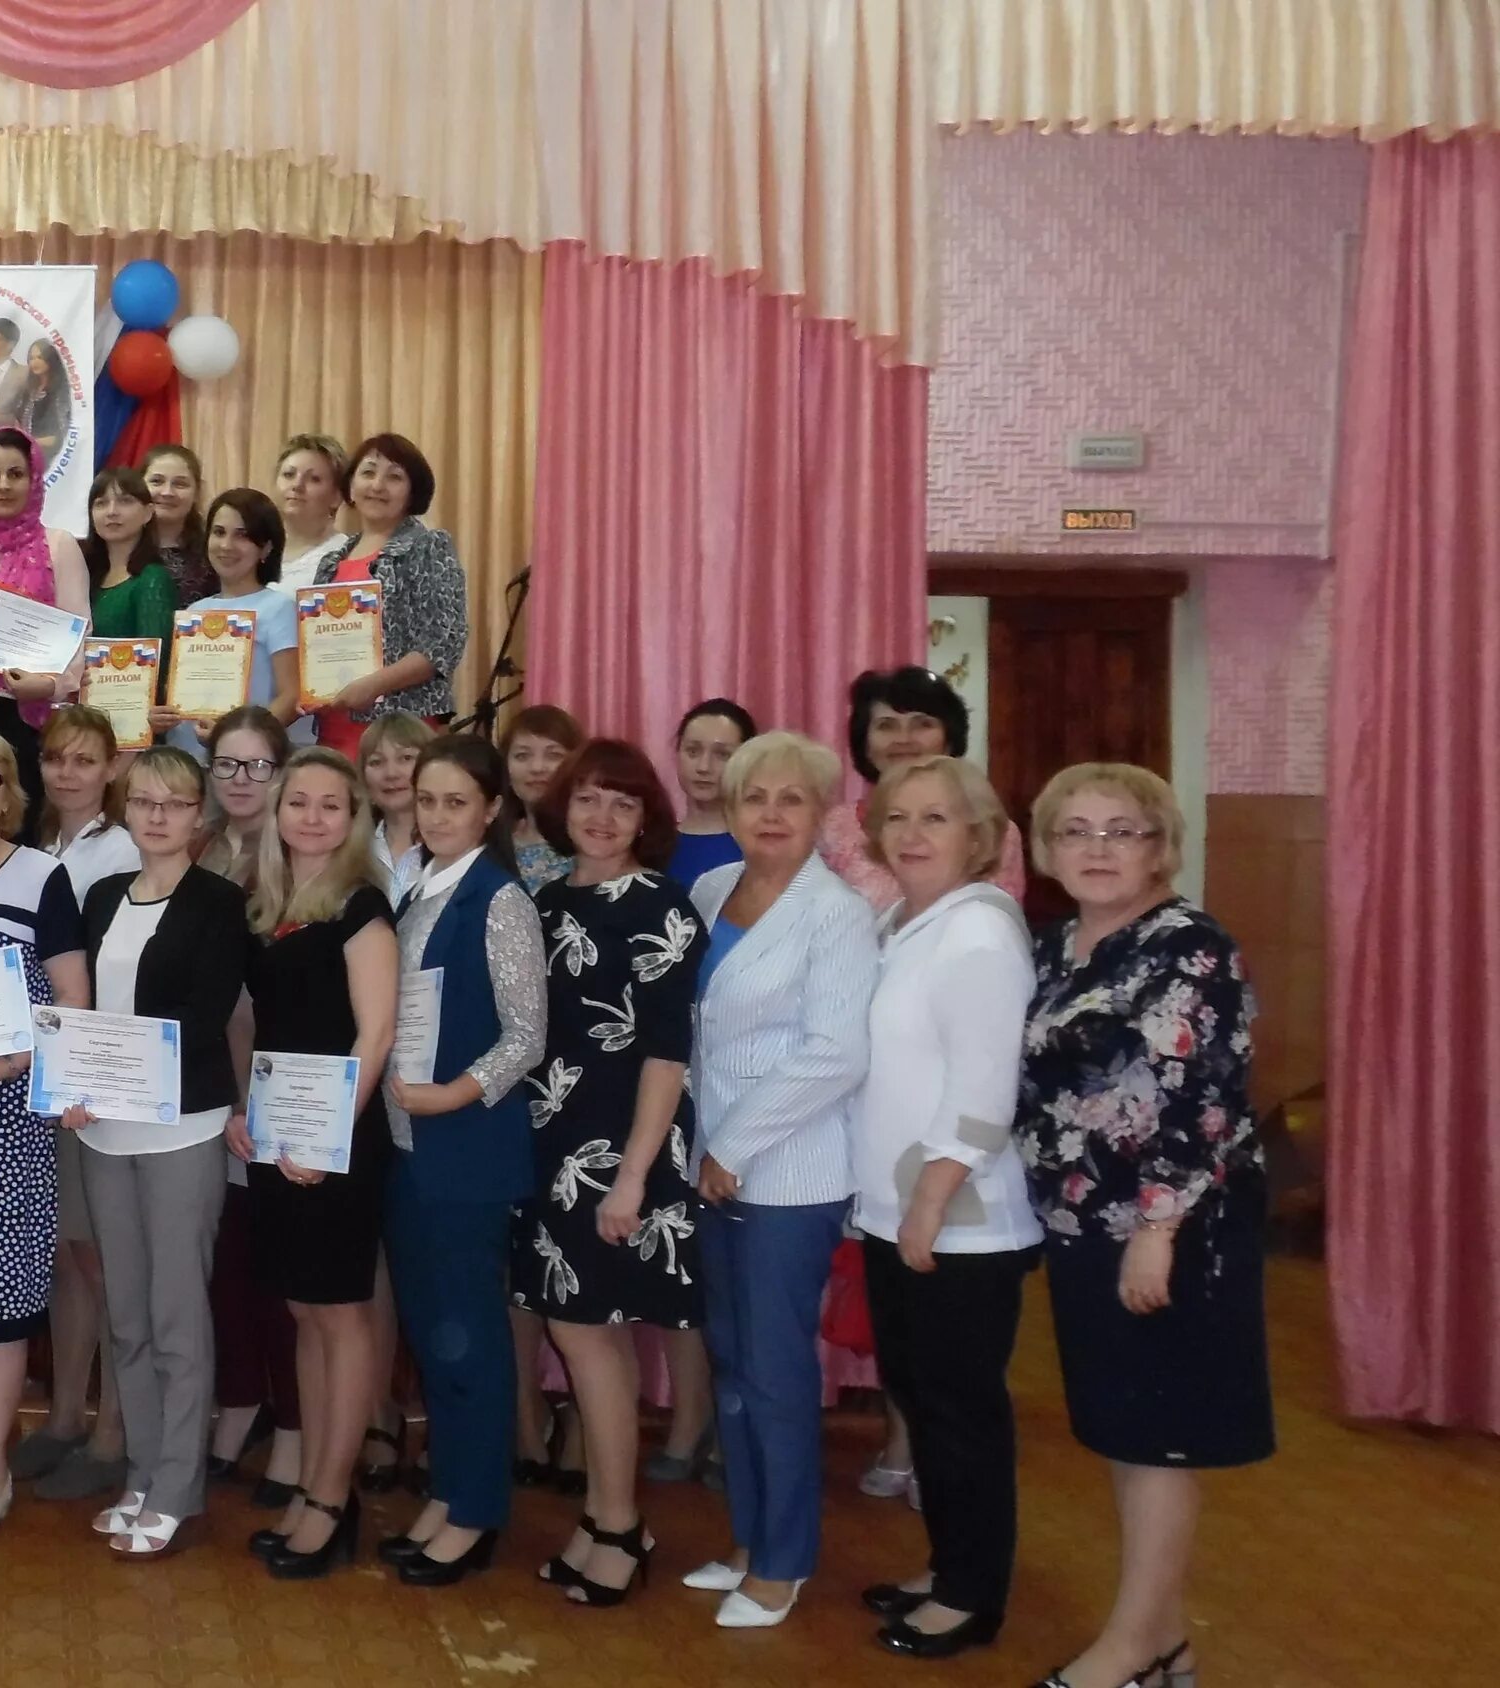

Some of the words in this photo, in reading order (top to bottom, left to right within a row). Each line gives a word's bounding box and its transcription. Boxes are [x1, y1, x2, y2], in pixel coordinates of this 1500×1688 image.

[42, 425, 79, 489] твуемся!
[1065, 512, 1133, 529] ВЫХОД
[314, 621, 363, 634] ДИПЛОМ
[187, 644, 236, 653] ДИПЛОМ
[97, 673, 142, 684] ДИПЛОМ
